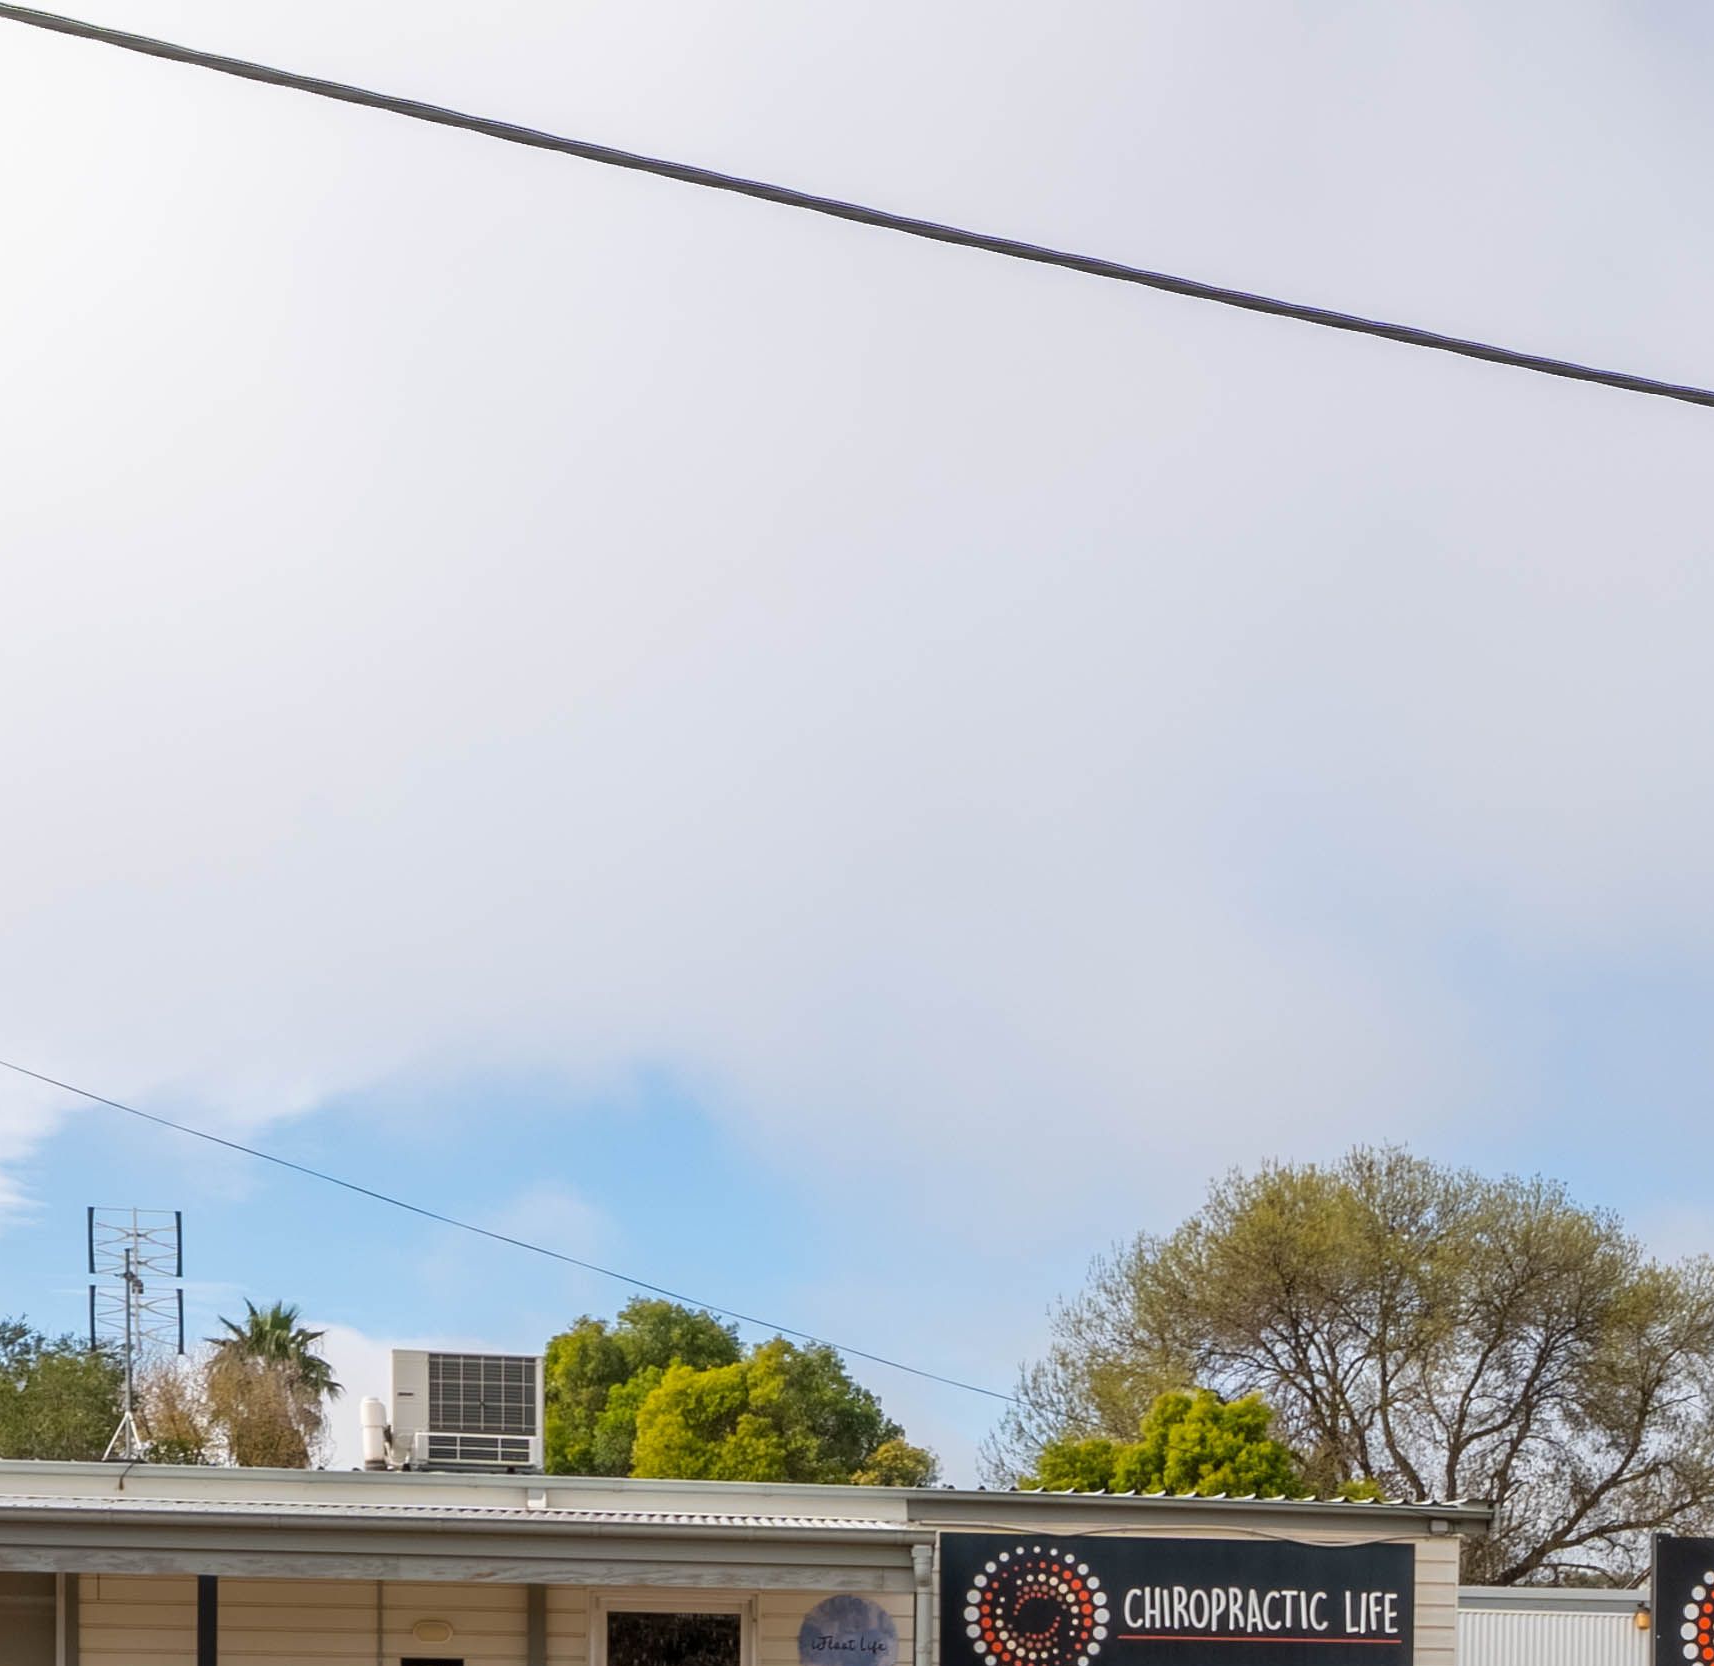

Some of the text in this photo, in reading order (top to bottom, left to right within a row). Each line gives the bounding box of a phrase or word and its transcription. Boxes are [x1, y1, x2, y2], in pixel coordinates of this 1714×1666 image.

[1123, 1586, 1399, 1634] CHIROPRACTIC LIFE
[860, 1636, 887, 1653] Life
